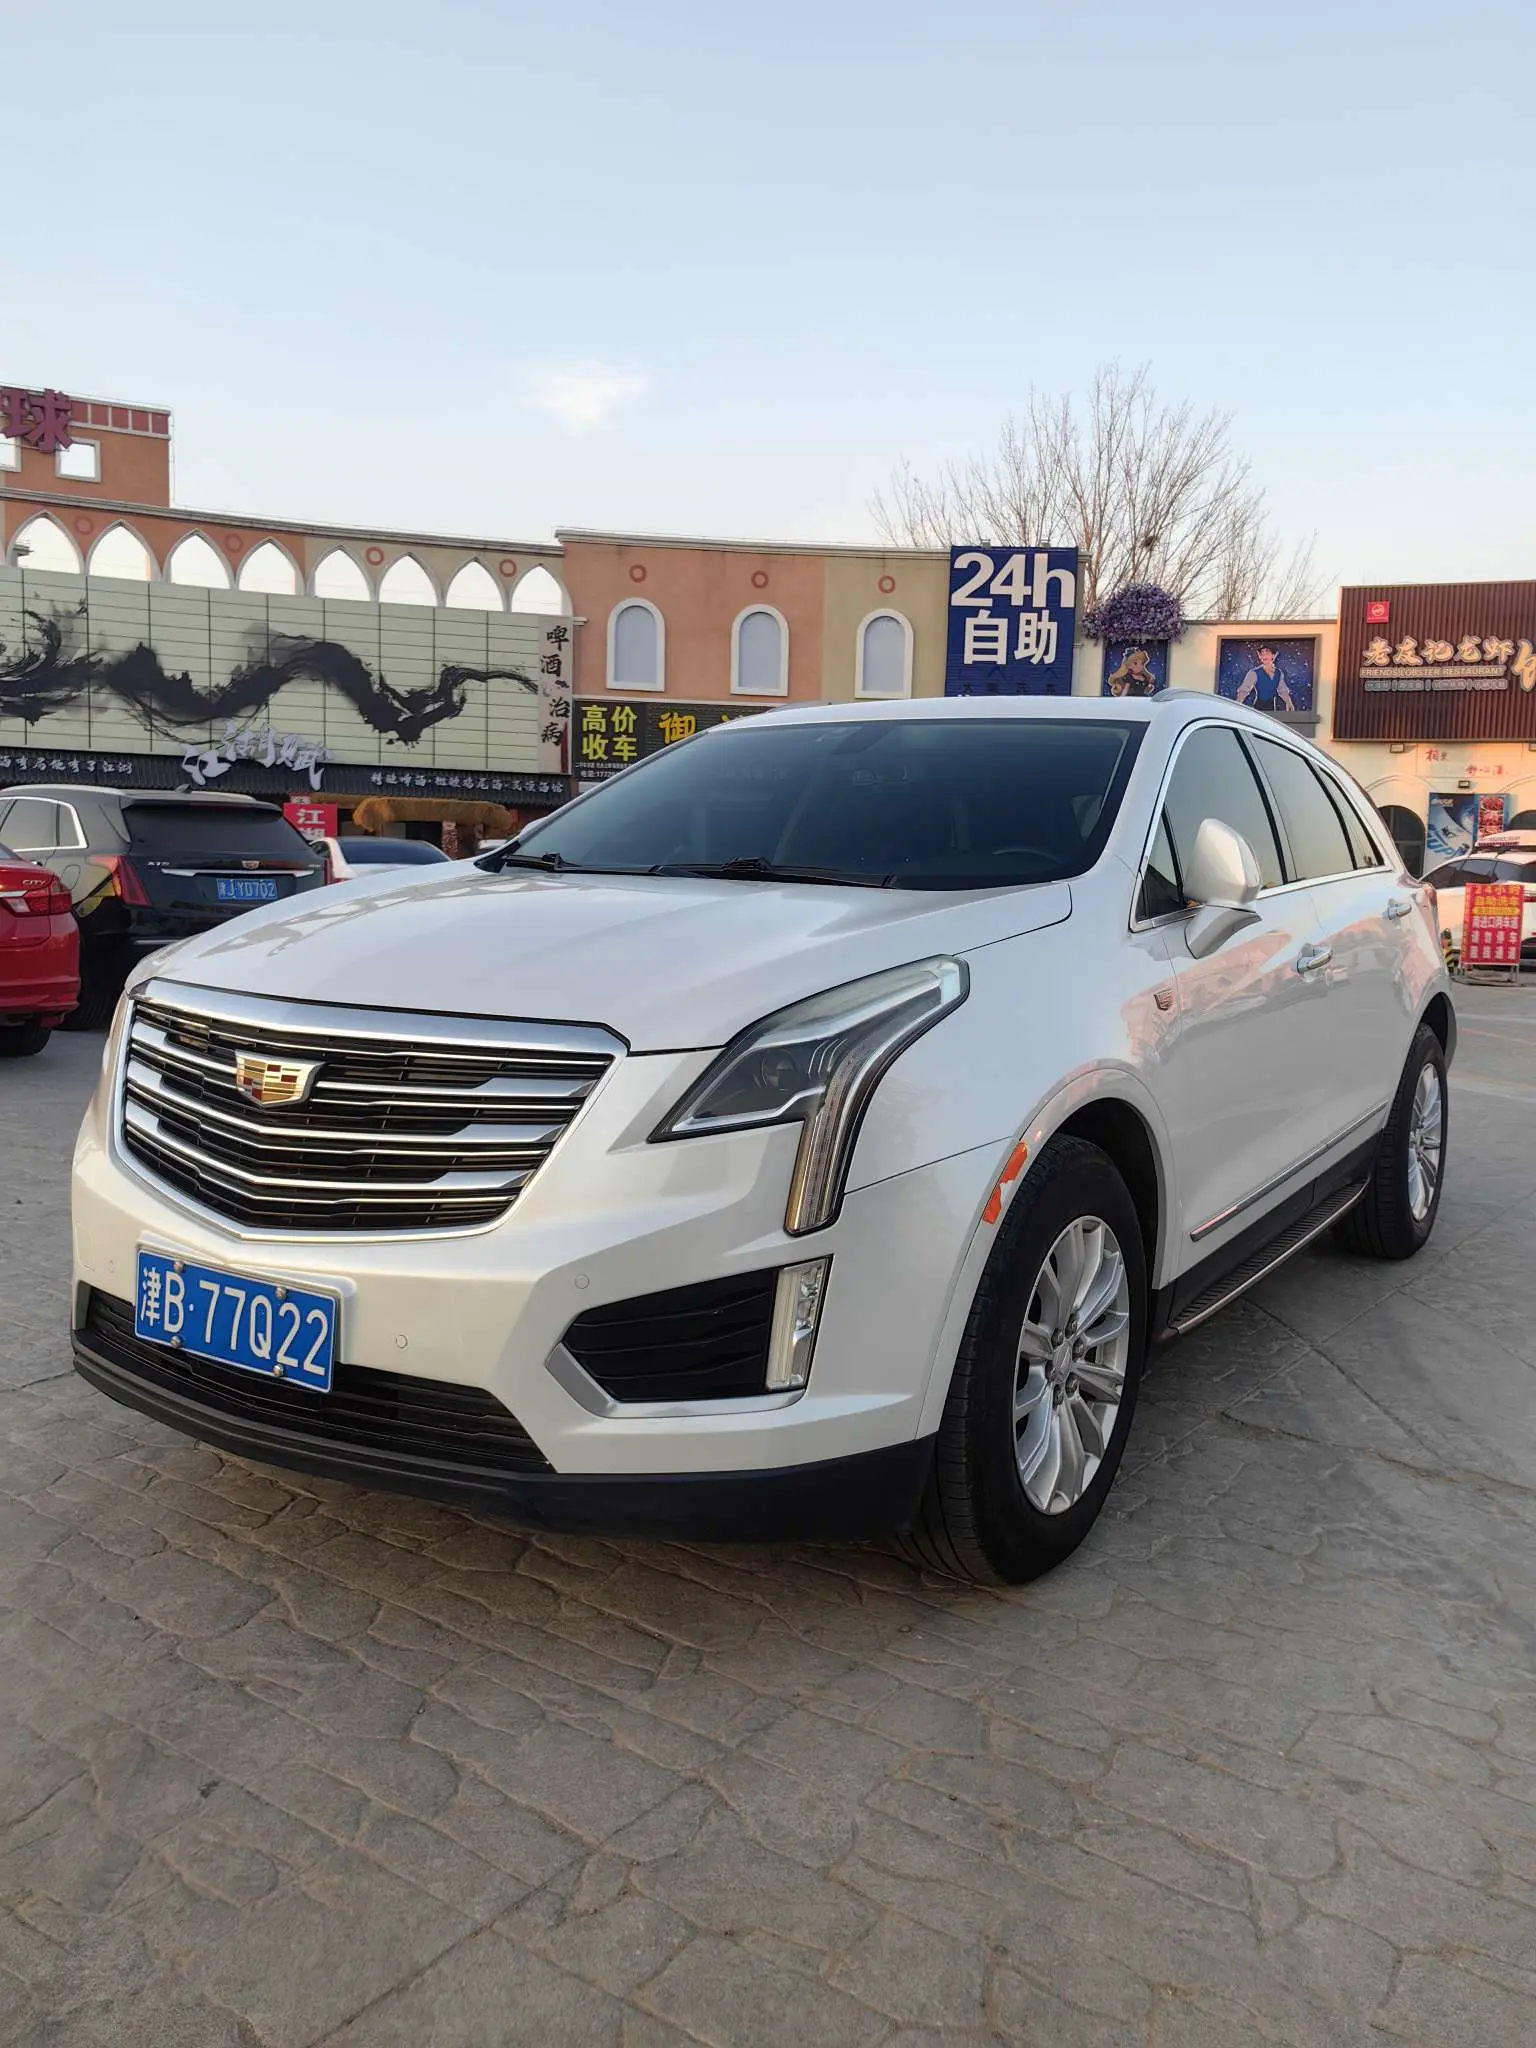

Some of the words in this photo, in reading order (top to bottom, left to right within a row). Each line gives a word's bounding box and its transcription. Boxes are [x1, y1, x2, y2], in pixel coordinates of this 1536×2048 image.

[950, 552, 1076, 608] 24h
[963, 608, 1058, 665] 自助
[1442, 666, 1505, 676] RESTAURANT
[581, 704, 638, 733] 高价
[581, 734, 638, 762] 收车
[141, 1266, 328, 1377] 津B·77Q22
